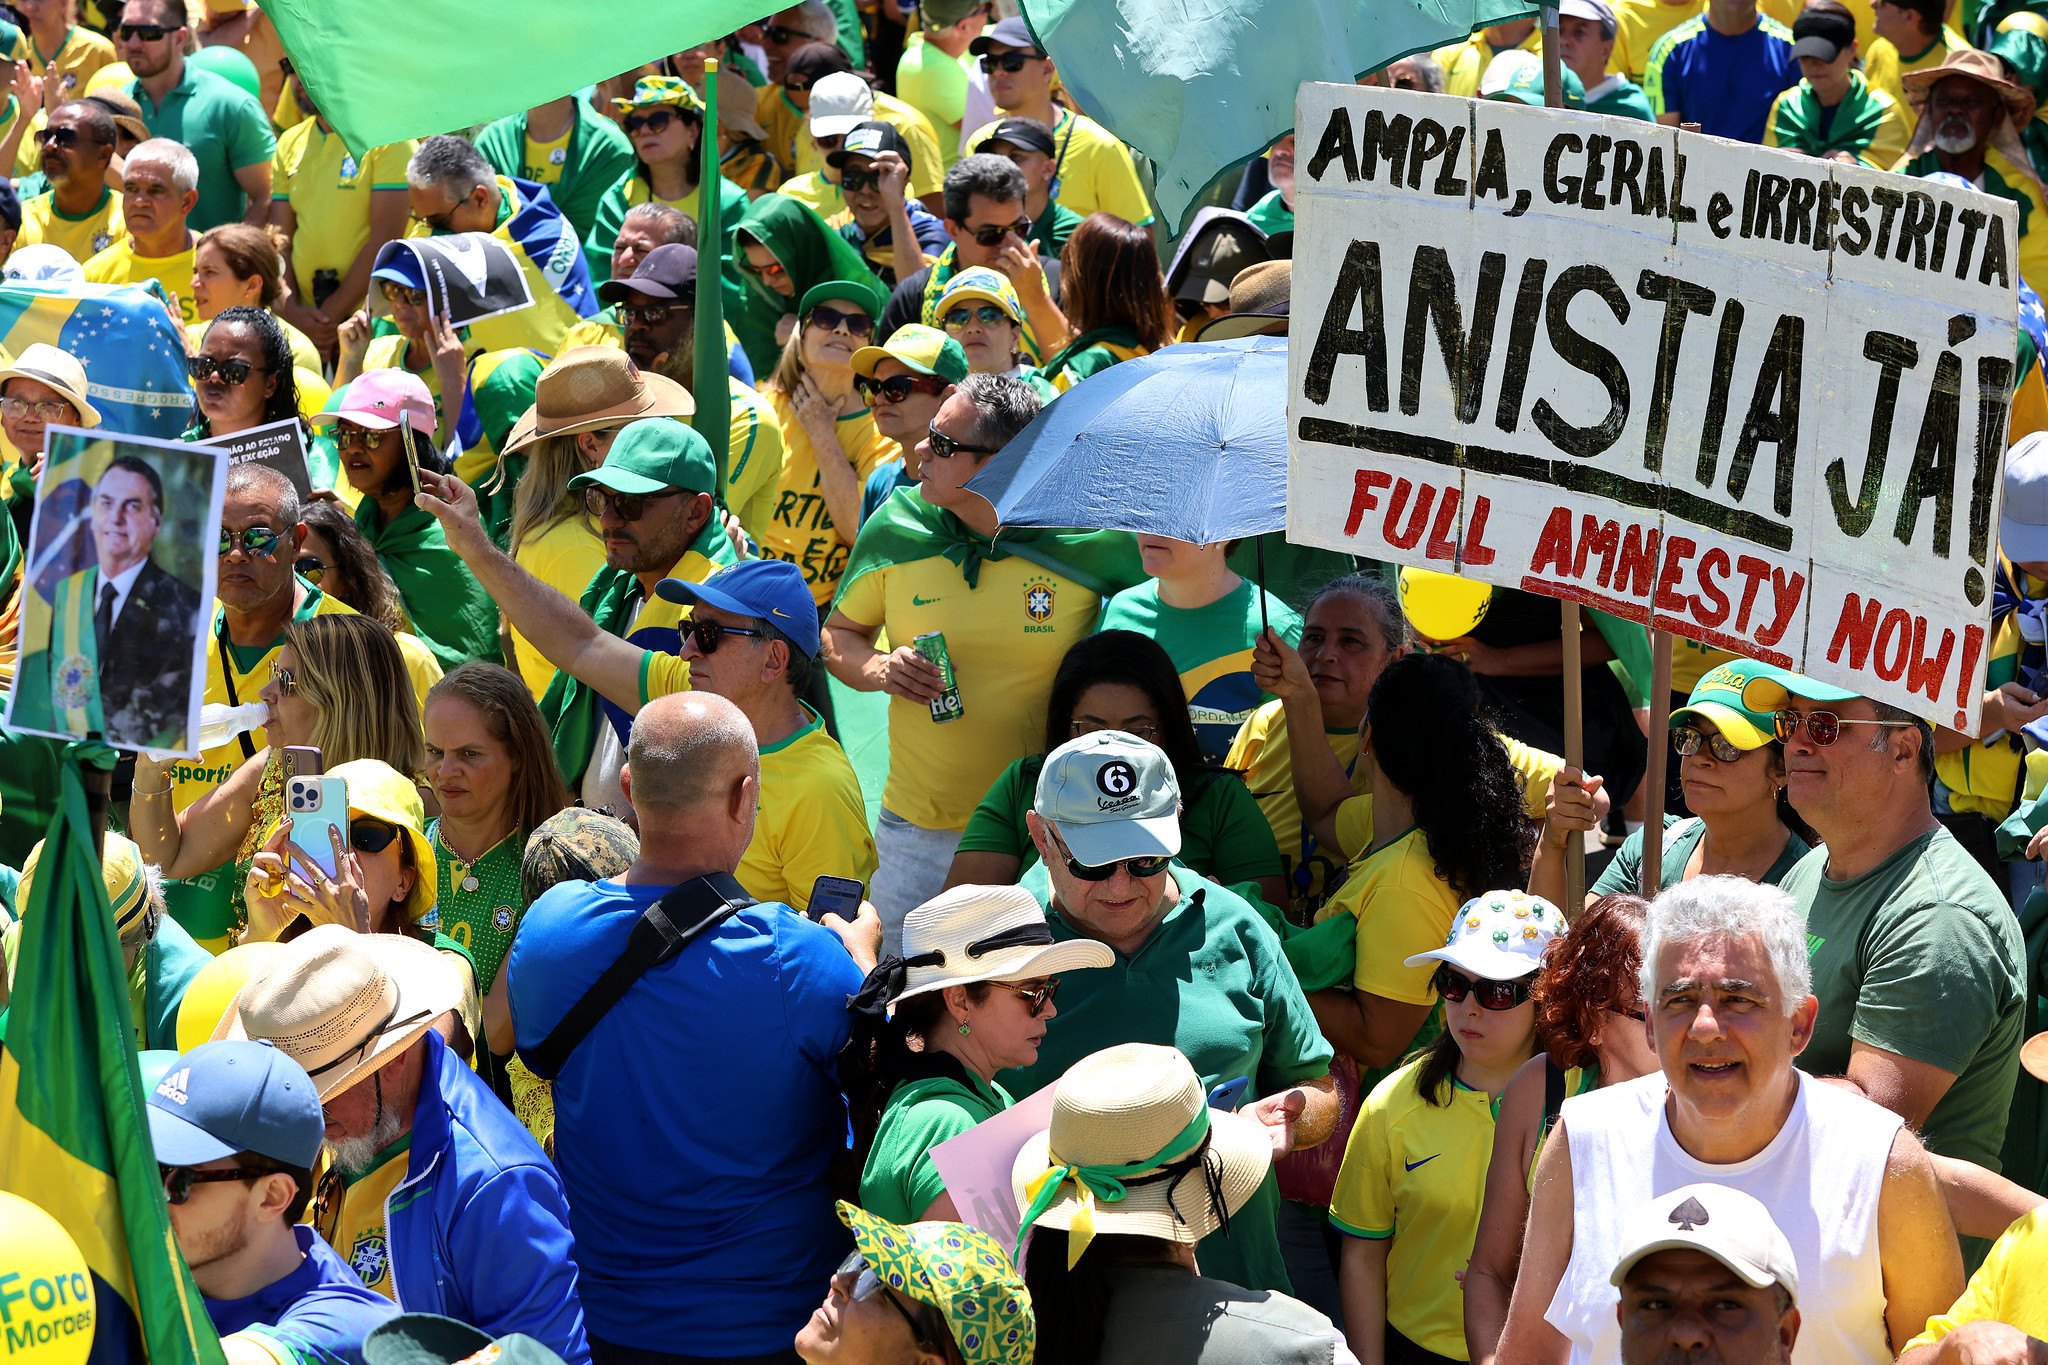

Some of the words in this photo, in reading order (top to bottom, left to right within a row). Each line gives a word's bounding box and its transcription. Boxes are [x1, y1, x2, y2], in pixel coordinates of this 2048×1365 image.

[1308, 106, 1532, 217] AMPLA,
[1543, 133, 1697, 223] GERAL
[1707, 191, 1734, 240] e
[1740, 168, 2010, 289] IRRESTRITA
[88, 385, 191, 405] PROGRESSO
[1304, 238, 1805, 518] ANISTIA
[1824, 312, 2016, 608] JÁ!
[245, 441, 257, 452] AO
[229, 456, 240, 466] DE
[1344, 469, 1496, 566] FULL
[1530, 506, 1805, 647] AMNESTY
[1826, 592, 1984, 732] NOW!
[1024, 625, 1056, 633] BRASIL
[1704, 665, 1746, 688] Bra
[1104, 765, 1130, 793] 6
[156, 1083, 189, 1106] adidas
[361, 1254, 378, 1264] CBF
[0, 1271, 88, 1324] Fora
[6, 1310, 90, 1355] Moraes
